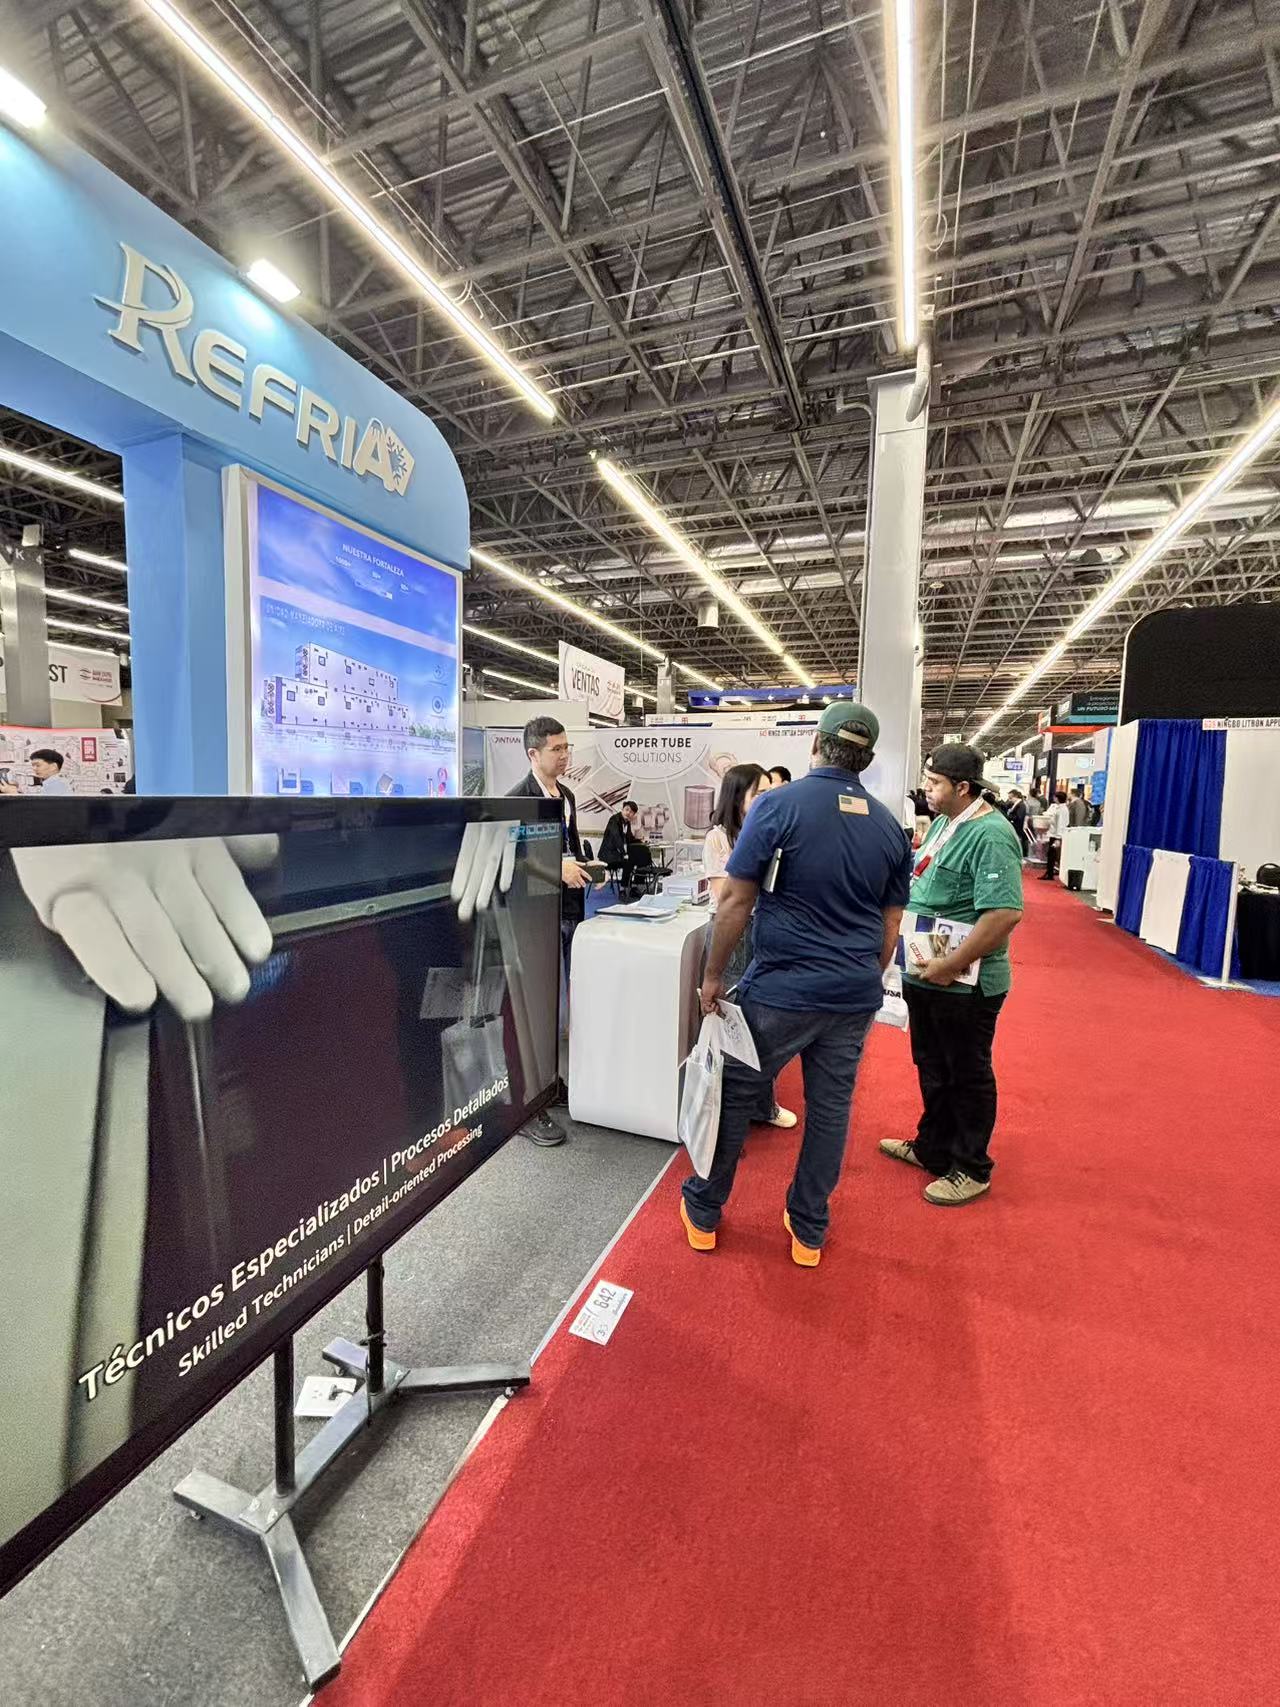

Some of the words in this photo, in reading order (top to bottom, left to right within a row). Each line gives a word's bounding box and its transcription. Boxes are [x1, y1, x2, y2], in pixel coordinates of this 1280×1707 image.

[571, 667, 600, 697] VENTAS
[614, 738, 658, 748] COPPER
[661, 737, 692, 748] TUBE
[623, 752, 682, 763] SOLUTIONS
[78, 1283, 225, 1401] Técnicos
[231, 1169, 381, 1291] Especializados
[391, 1117, 452, 1173] Procesos
[453, 1075, 509, 1127] Detallados
[177, 1307, 247, 1377] Skilled
[251, 1234, 345, 1316] Technicians
[353, 1159, 436, 1236] Detail-oriented
[437, 1123, 483, 1168] Processing
[593, 1287, 617, 1309] 642
